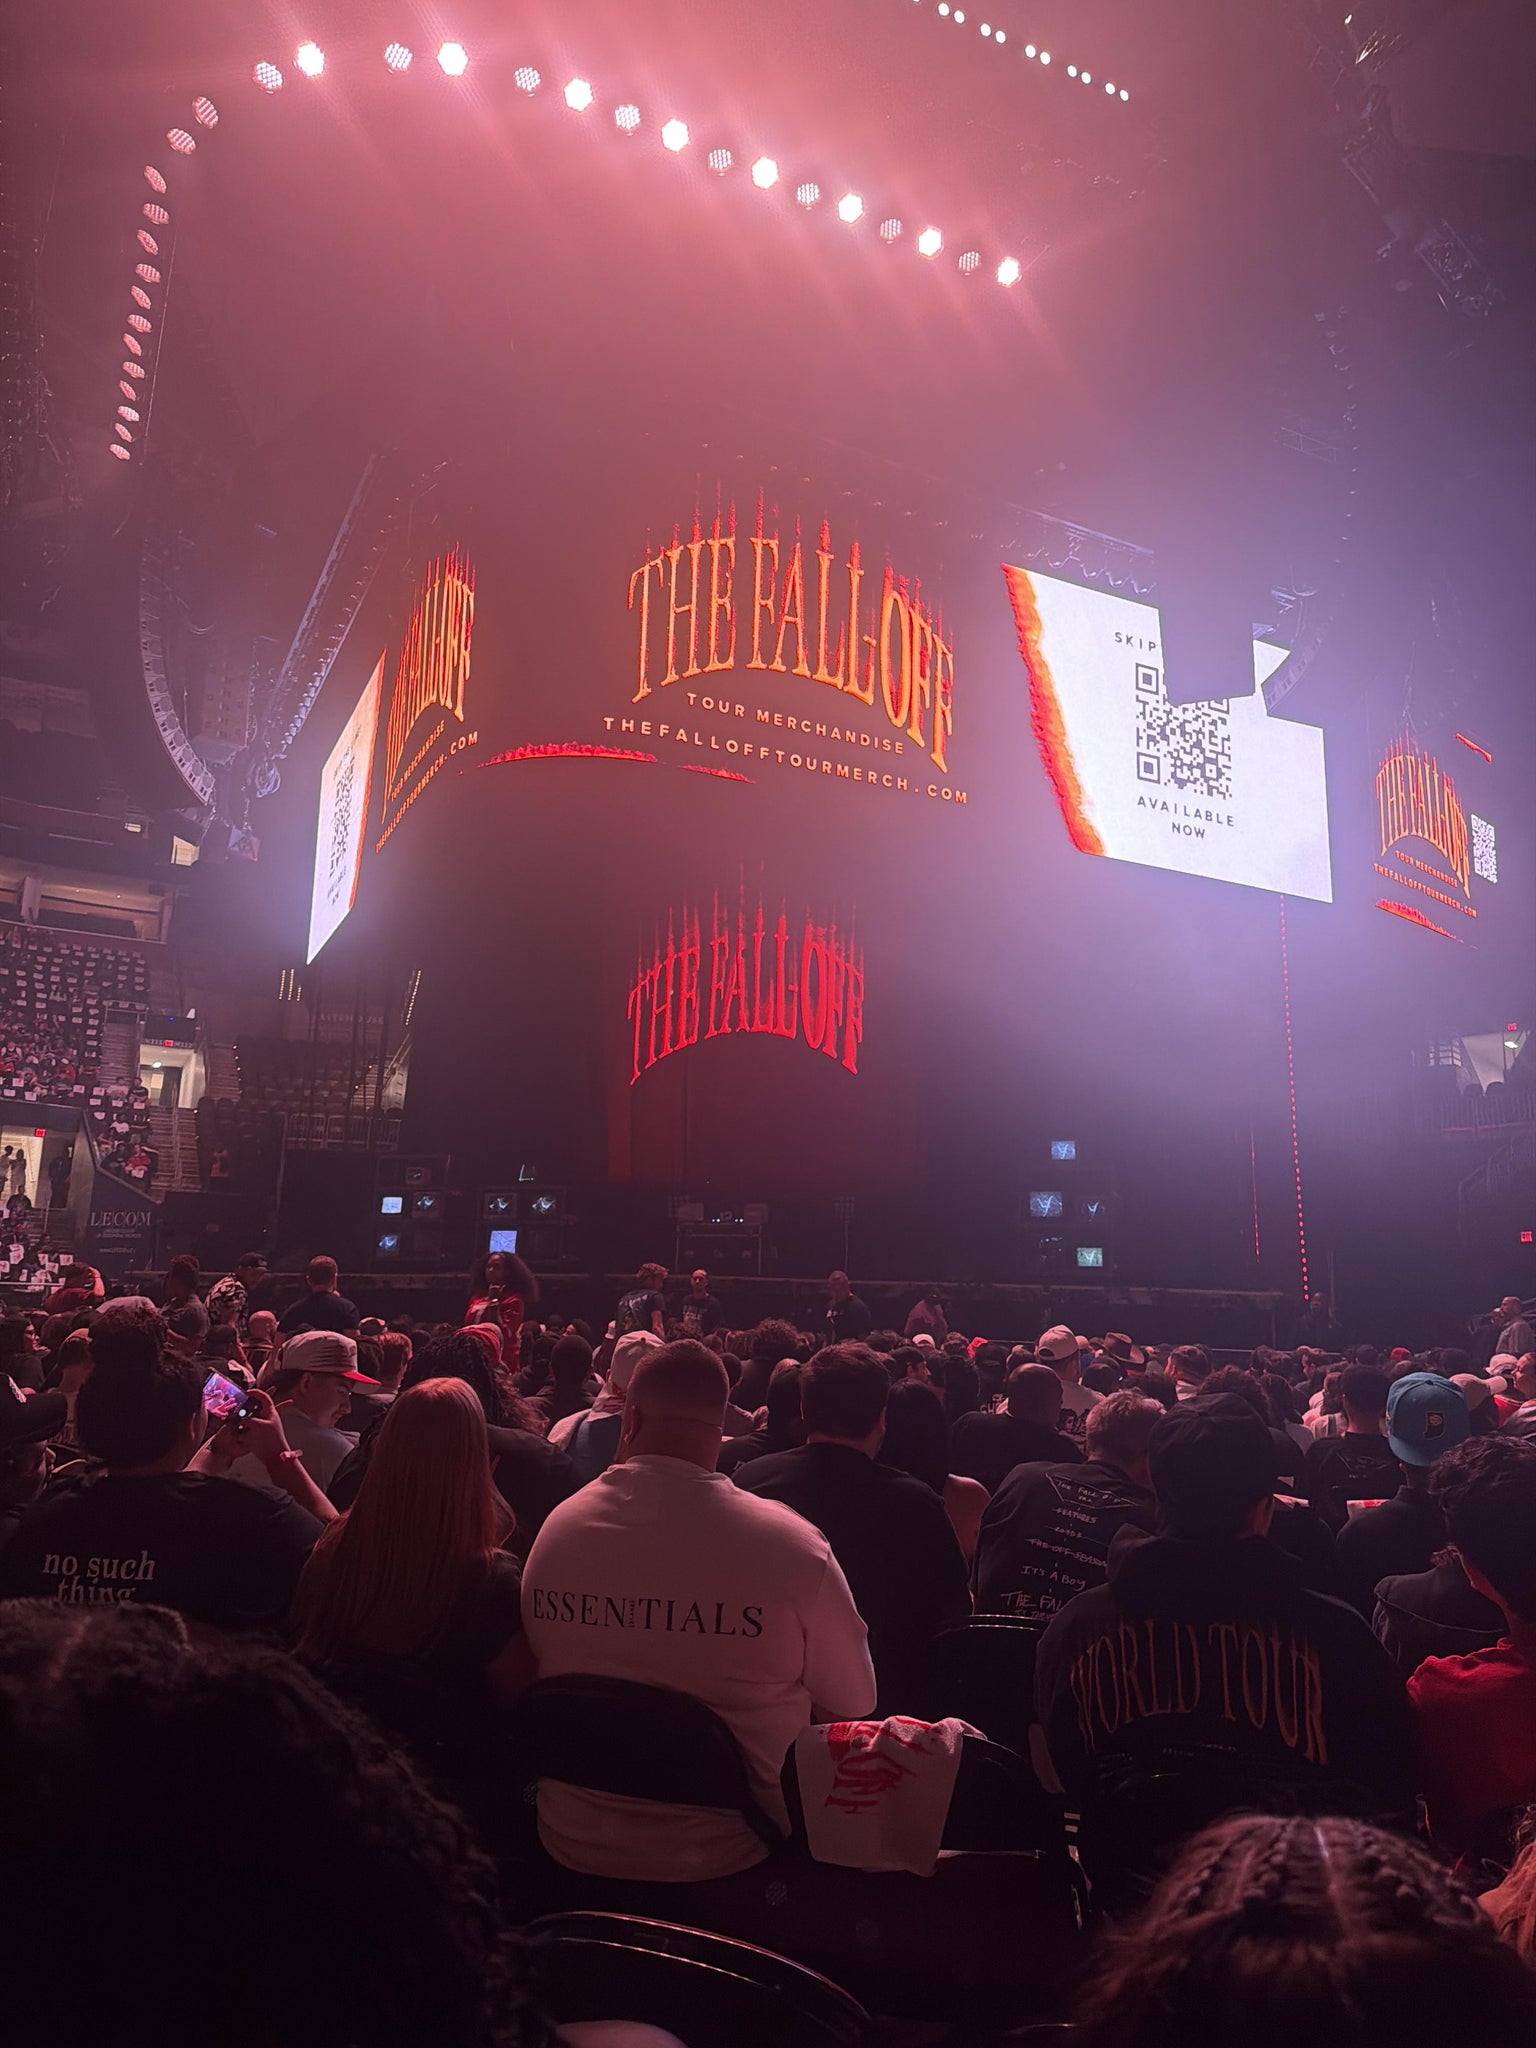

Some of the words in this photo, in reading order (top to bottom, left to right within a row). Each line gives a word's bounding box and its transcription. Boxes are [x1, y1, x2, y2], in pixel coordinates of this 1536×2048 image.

[628, 526, 736, 704] THE
[1114, 631, 1157, 652] SKIP
[687, 691, 746, 718] TOUR
[756, 708, 905, 755] MERCHANDISE
[1137, 795, 1235, 827] AVAILABLE
[1171, 821, 1206, 839] NOW
[1395, 850, 1414, 866] TOUR
[1415, 860, 1458, 889] MERCHANDISE
[627, 938, 700, 1086] THE
[90, 1211, 152, 1227] LECOM
[42, 1553, 78, 1576] no
[86, 1550, 156, 1580] such
[533, 1588, 763, 1638] ESSENTIALS
[1069, 1618, 1200, 1751] WORLD
[1208, 1619, 1328, 1765] TOUR
